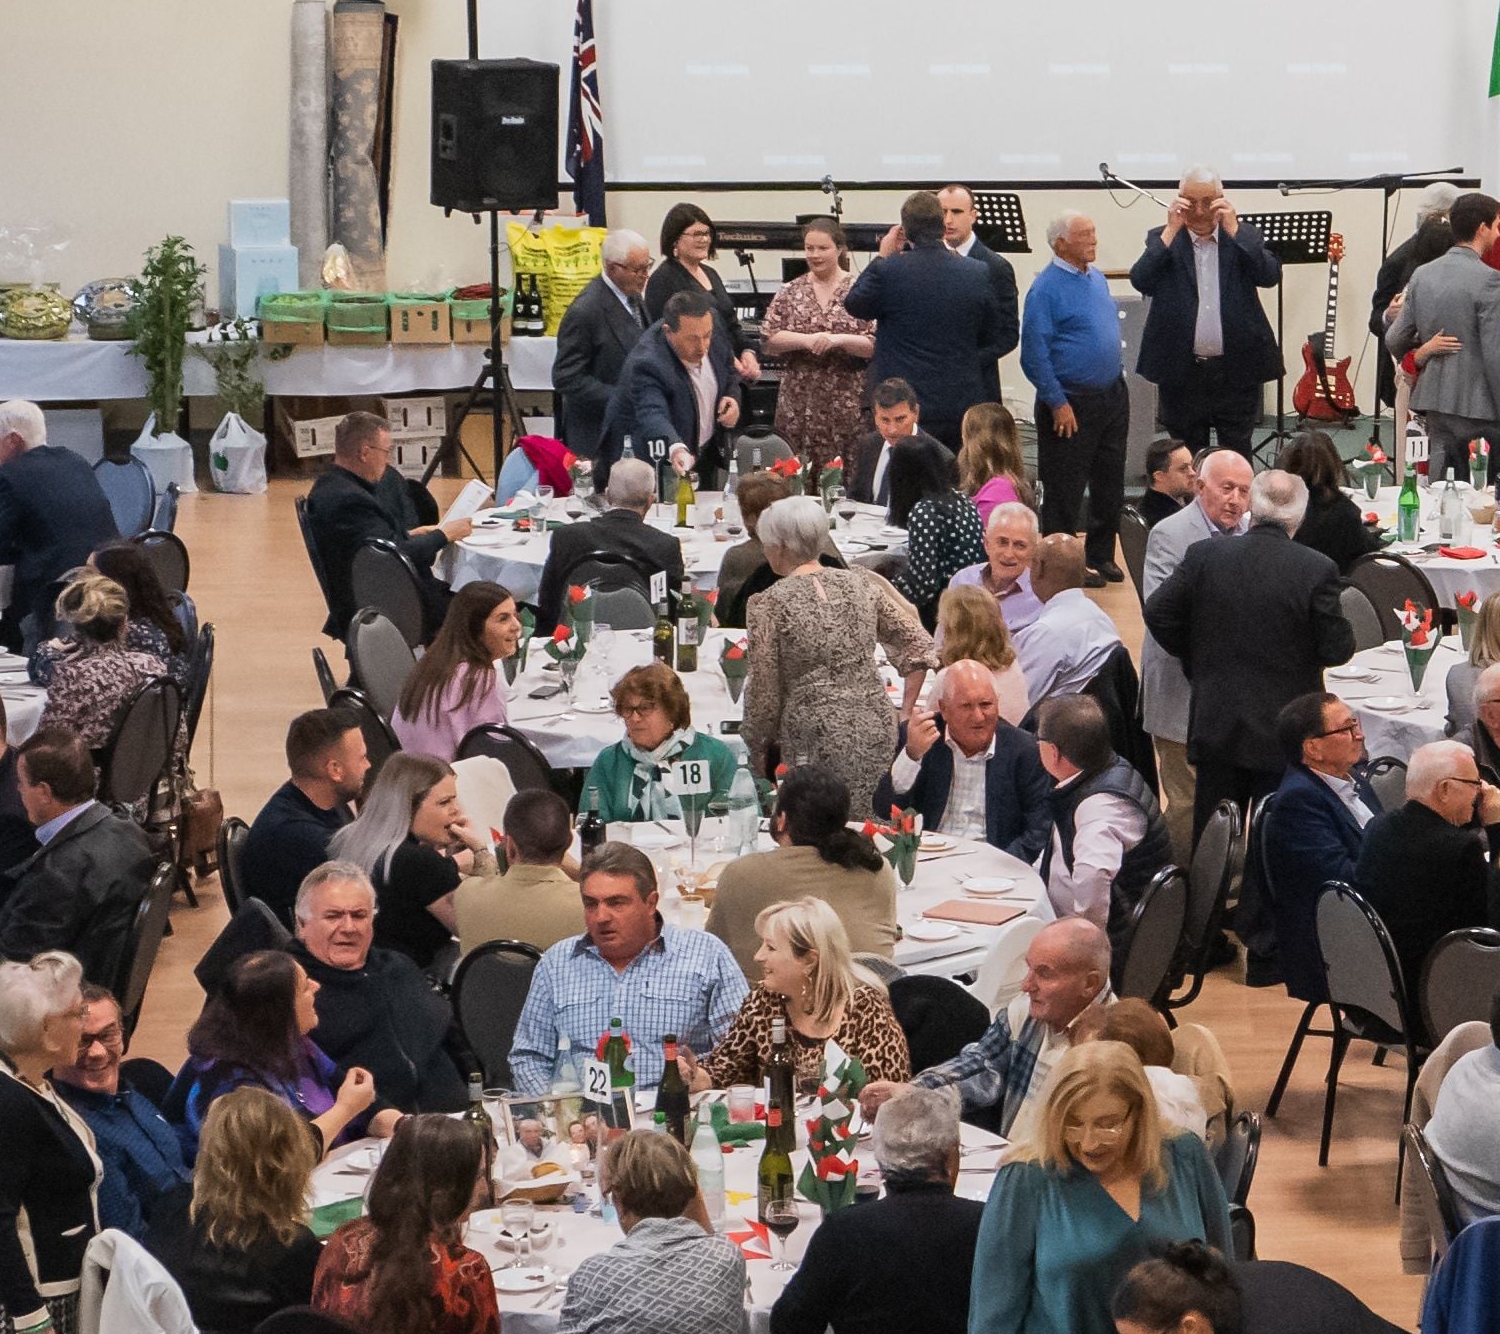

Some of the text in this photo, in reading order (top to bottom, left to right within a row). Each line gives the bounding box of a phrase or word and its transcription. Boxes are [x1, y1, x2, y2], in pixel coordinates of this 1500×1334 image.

[647, 439, 666, 457] 10
[1410, 439, 1426, 459] 11
[680, 762, 702, 785] 18
[589, 1066, 607, 1096] 22
